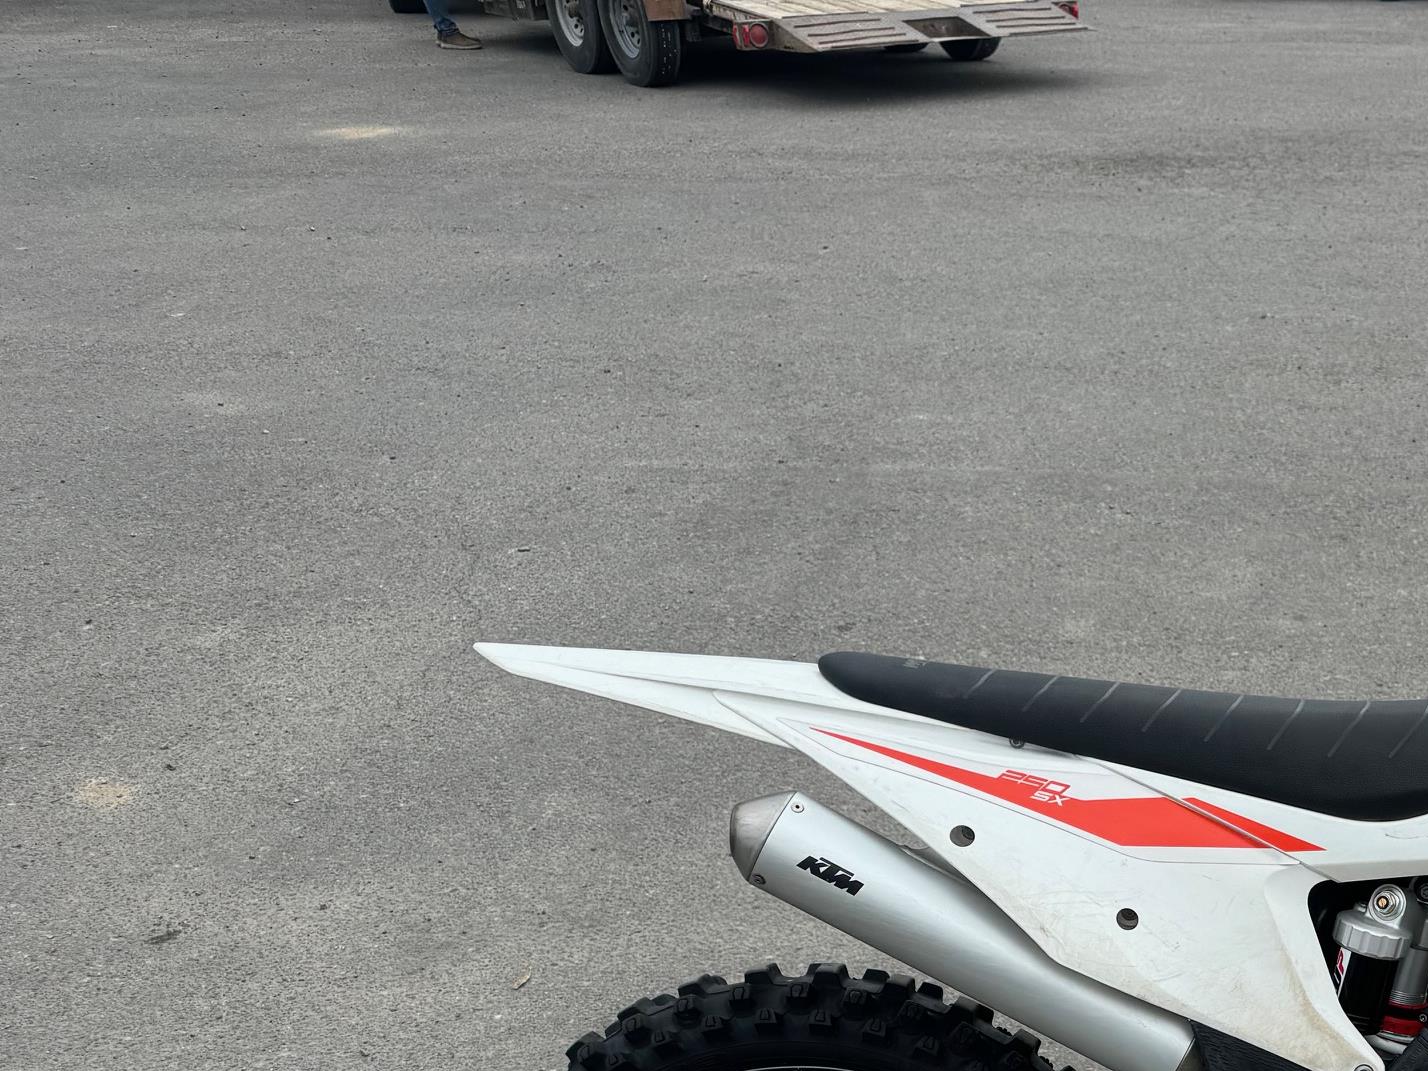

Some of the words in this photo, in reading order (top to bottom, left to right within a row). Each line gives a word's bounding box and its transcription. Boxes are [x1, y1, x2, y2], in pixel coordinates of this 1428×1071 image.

[998, 769, 1071, 795] 250
[1030, 790, 1071, 807] SX
[796, 855, 864, 896] KTM
